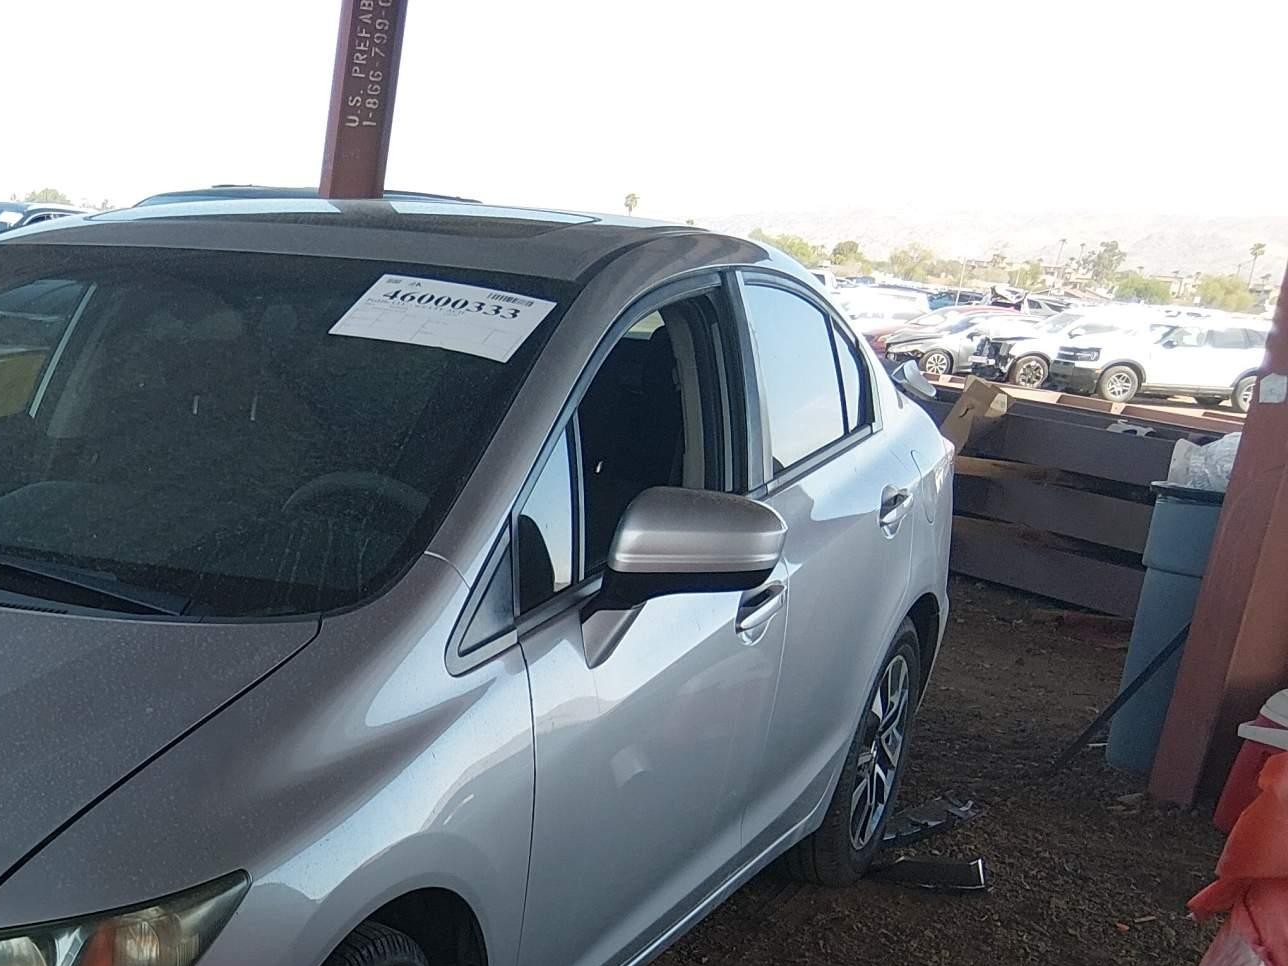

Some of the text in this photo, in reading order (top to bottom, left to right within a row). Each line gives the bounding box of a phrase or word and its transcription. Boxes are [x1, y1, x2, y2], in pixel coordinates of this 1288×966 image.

[345, 0, 374, 127] U.S. PREFAB
[382, 288, 521, 320] 46000333
